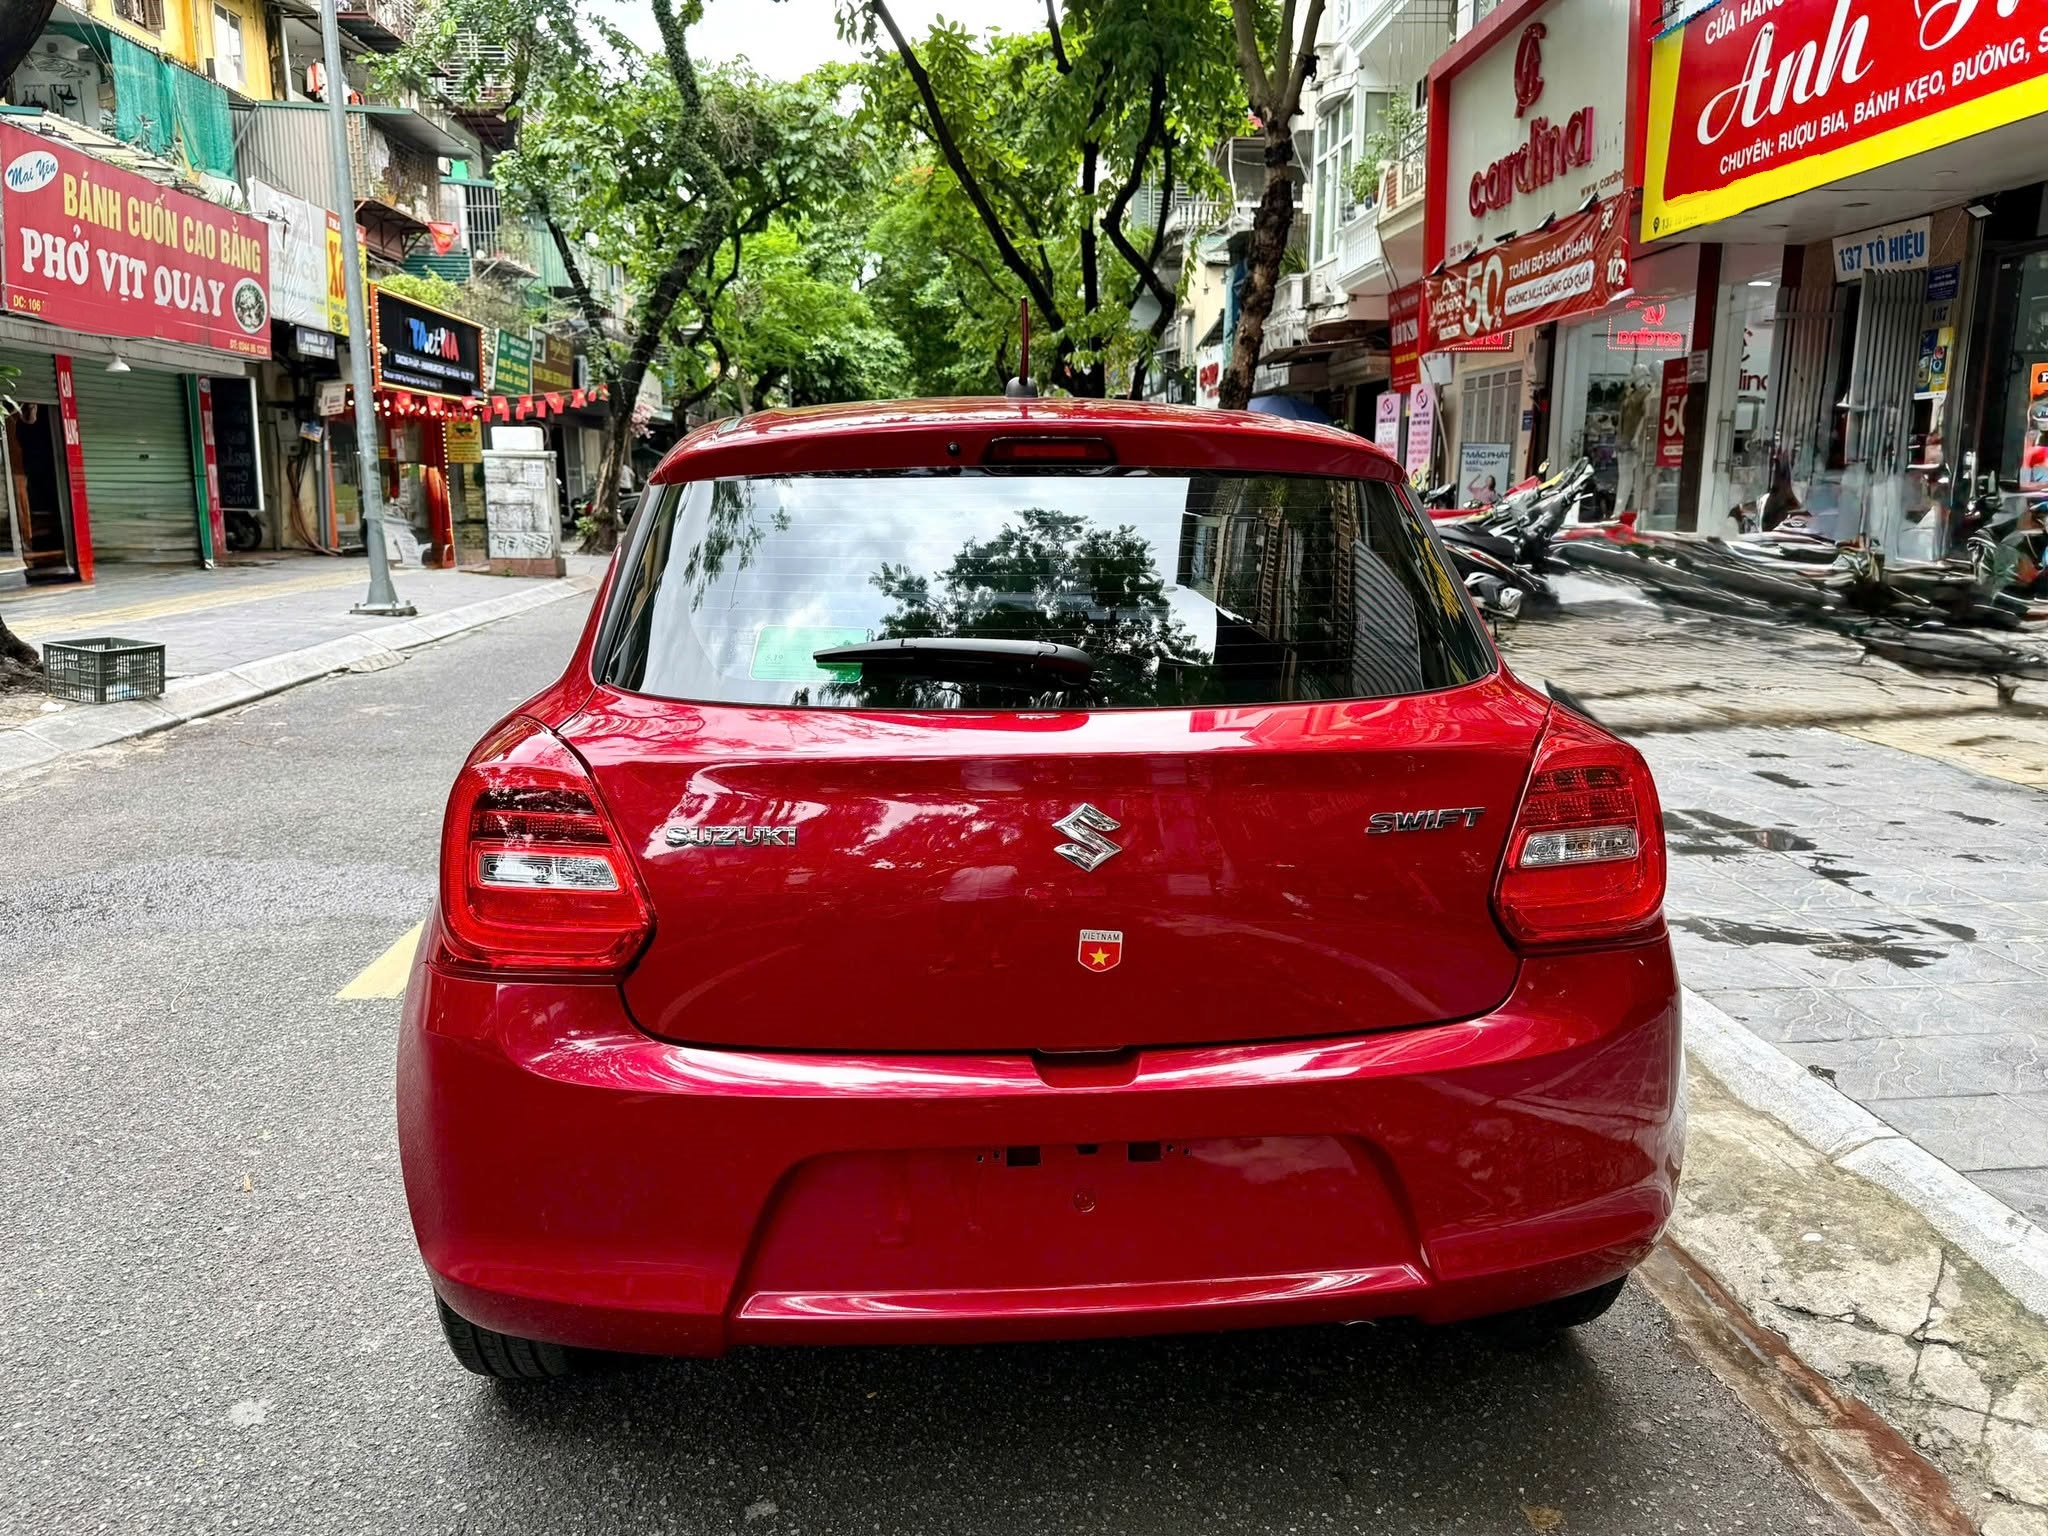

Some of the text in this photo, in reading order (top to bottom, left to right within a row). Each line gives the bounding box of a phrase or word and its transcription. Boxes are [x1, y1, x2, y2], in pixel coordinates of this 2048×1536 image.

[1705, 8, 1736, 45] CỬA
[1697, 0, 1874, 145] Anh
[1719, 138, 1775, 175] CHUYÊN:
[1778, 120, 1818, 150] RƯỢU
[1820, 110, 1849, 138] BIA,
[1853, 91, 1900, 125] BÁNH
[1904, 70, 1946, 104] KẸO,
[1951, 37, 2031, 87] ĐƯỜNG,
[8, 166, 34, 187] Mai
[1469, 106, 1594, 218] cardina
[63, 170, 122, 233] BÁNH
[127, 193, 178, 249] CUỐN
[182, 215, 216, 260] CAO
[220, 216, 262, 274] BẰNG
[1508, 258, 1531, 281] TOÀN
[1531, 250, 1544, 275] BỘ
[1545, 243, 1564, 268] SẢN
[1838, 228, 1926, 272] 137 TÔ HIỆU
[20, 223, 90, 286] PHỞ
[96, 248, 147, 302] VỊT
[154, 265, 225, 317] QUAY
[28, 298, 41, 312] 106
[665, 825, 797, 847] SUZUKI
[1365, 807, 1486, 834] SWIFT
[1082, 931, 1120, 941] VIETNAM
